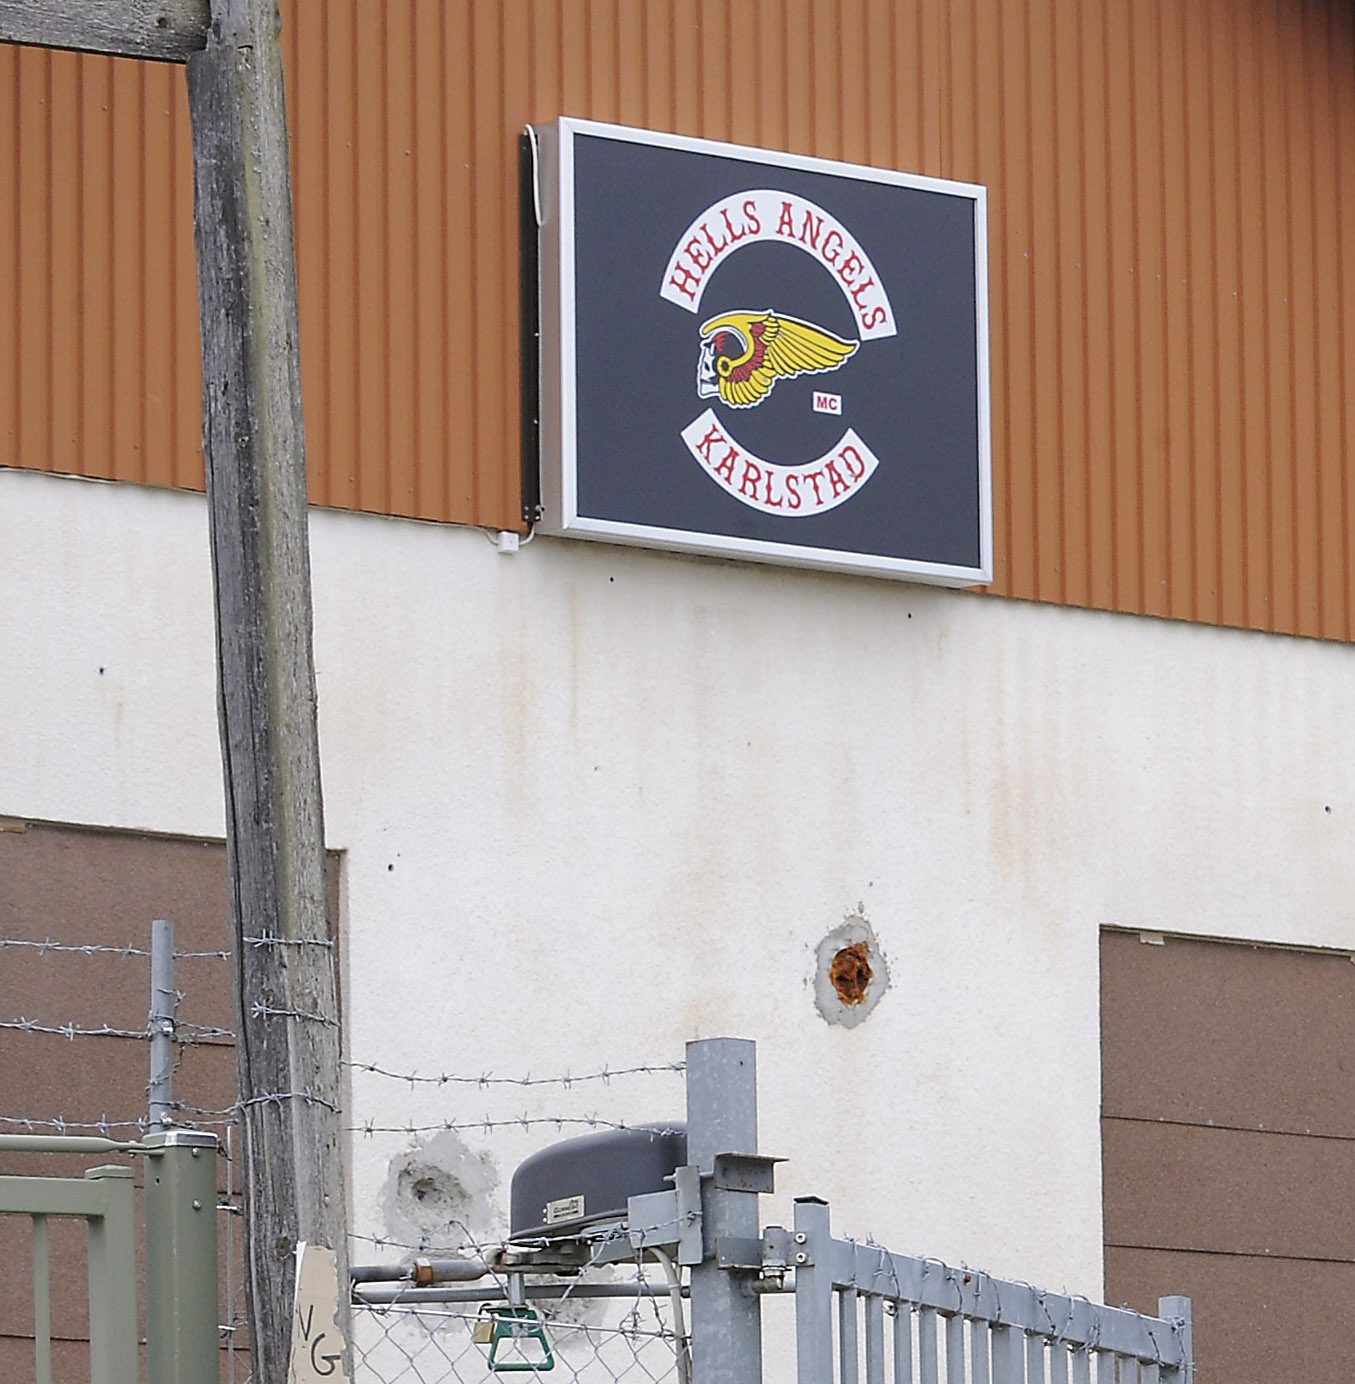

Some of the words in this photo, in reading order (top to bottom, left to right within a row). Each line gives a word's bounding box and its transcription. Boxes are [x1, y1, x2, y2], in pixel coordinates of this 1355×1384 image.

[669, 200, 761, 302] HELLS
[775, 201, 887, 330] ANGELS
[816, 396, 838, 411] MC
[696, 423, 866, 509] KARLSTAD
